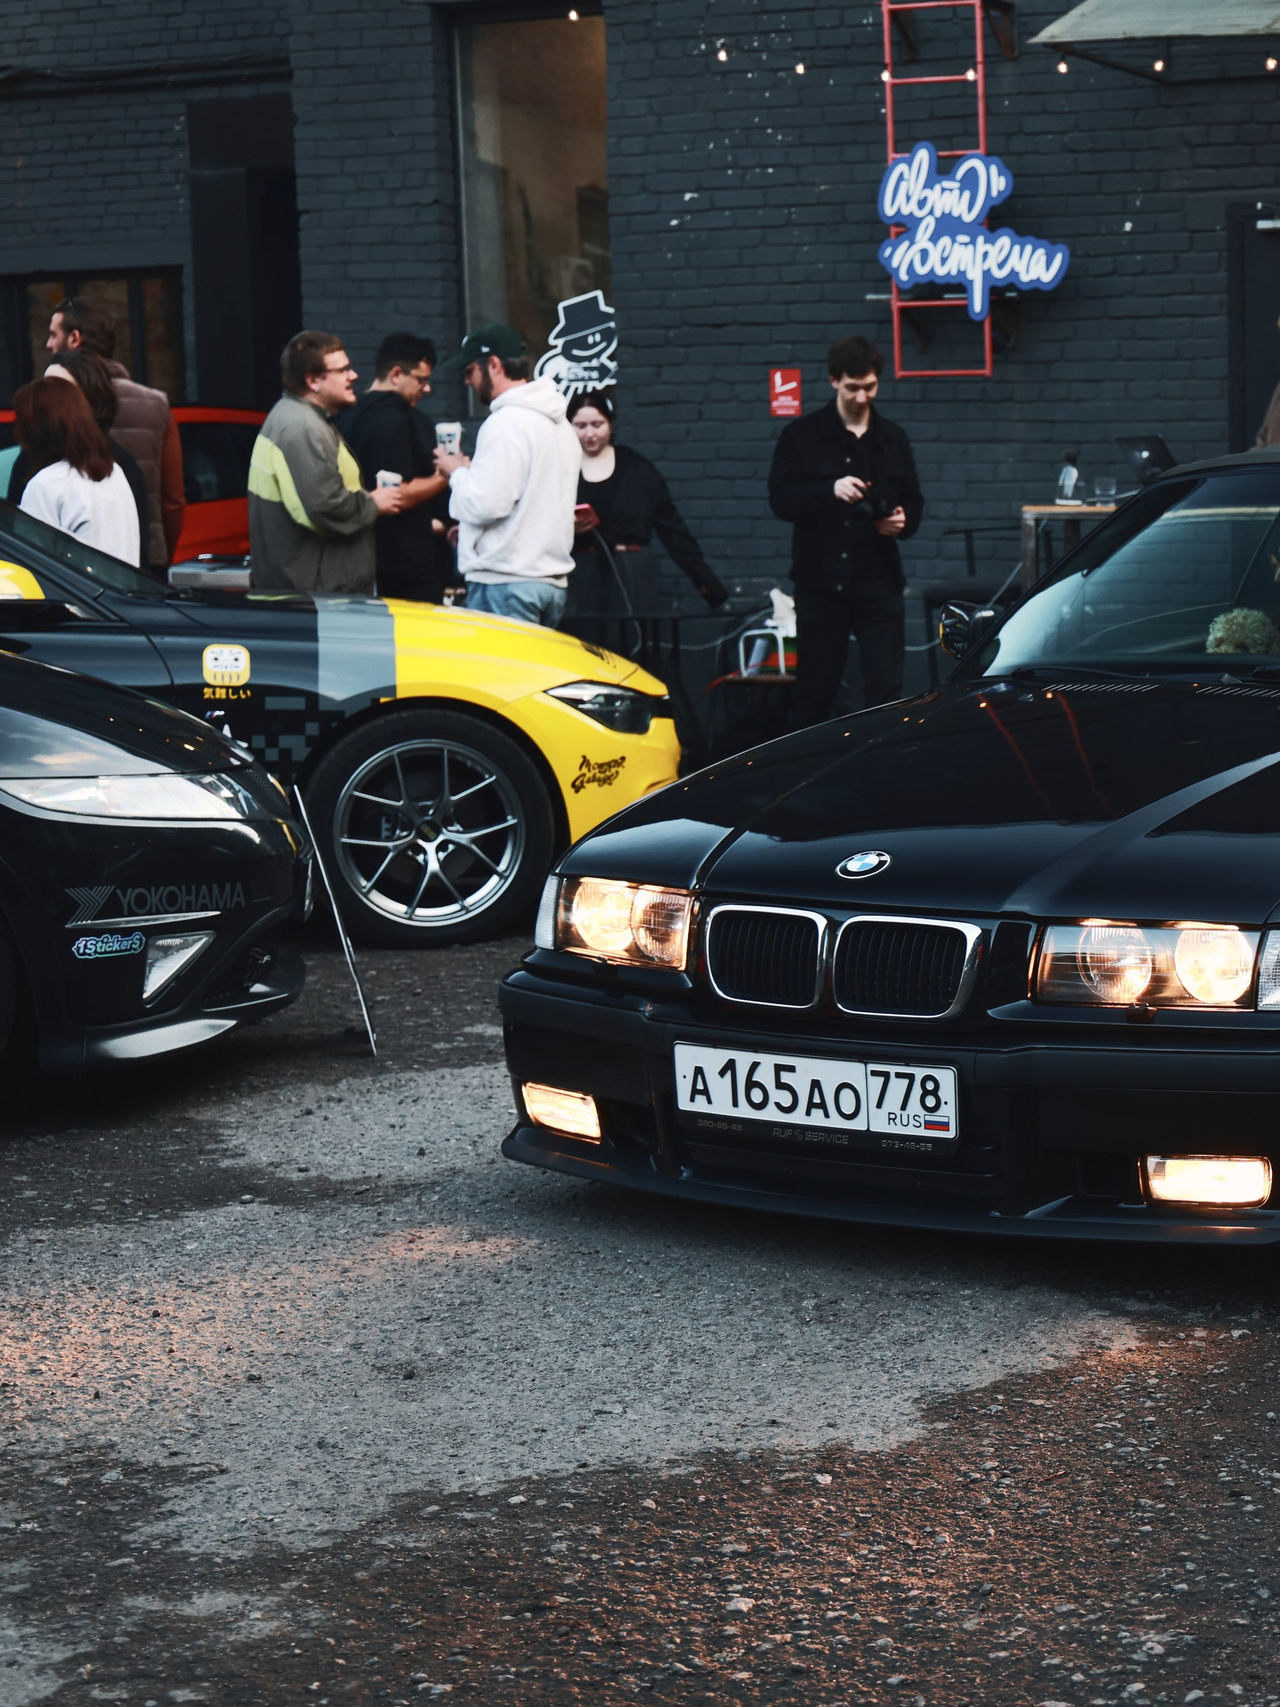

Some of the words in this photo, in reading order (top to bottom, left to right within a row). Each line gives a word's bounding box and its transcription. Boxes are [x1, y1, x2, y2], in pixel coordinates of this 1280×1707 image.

[115, 882, 246, 916] YOKOHAMA
[869, 1069, 942, 1114] 778
[887, 1111, 923, 1129] RUS
[772, 1127, 793, 1139] RUF
[803, 1130, 850, 1145] SERVICE
